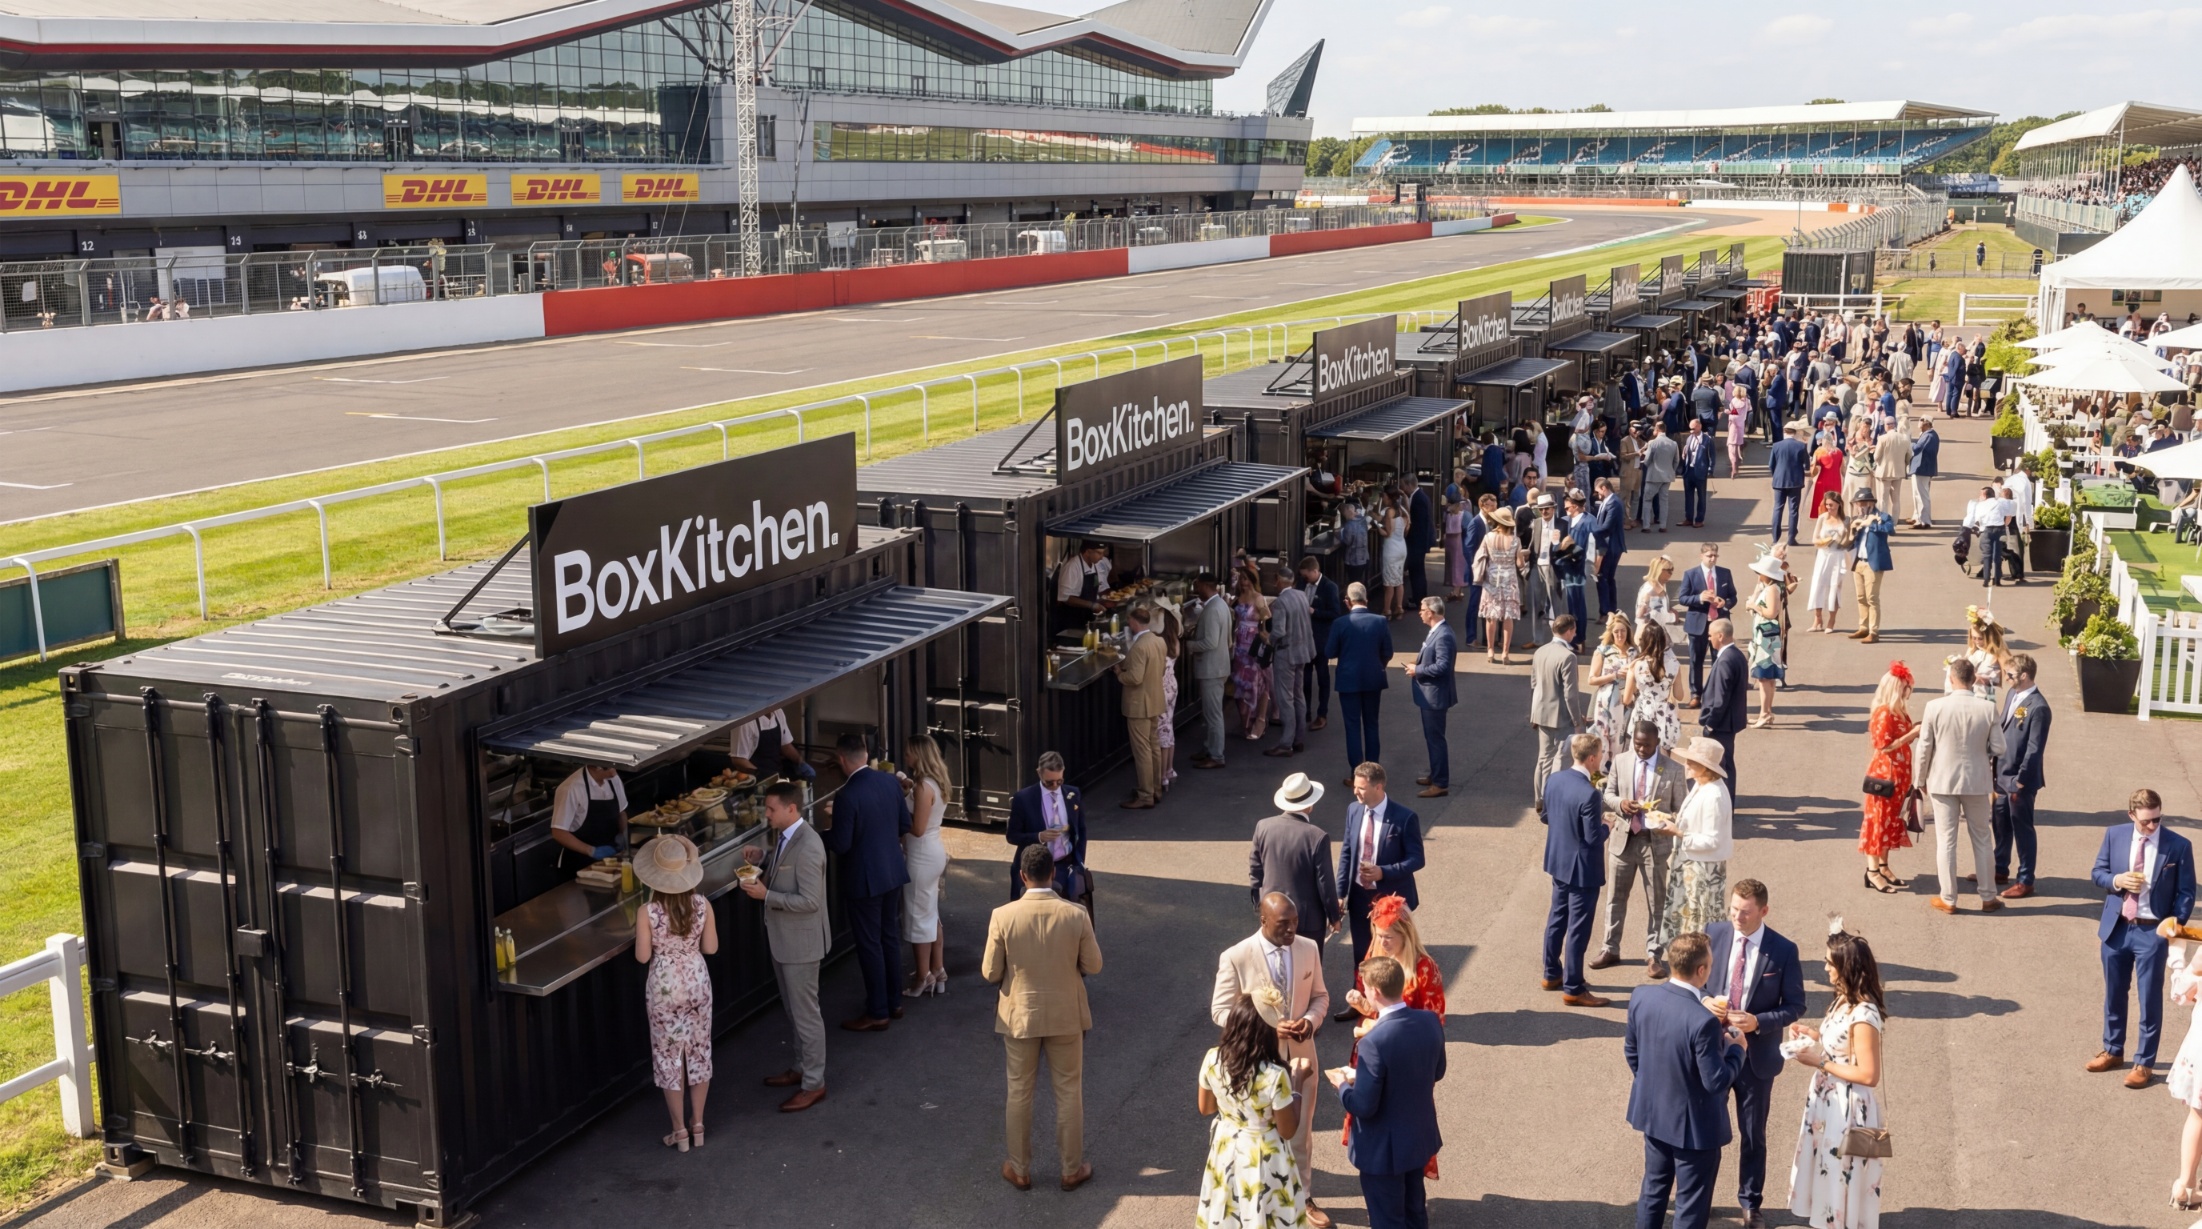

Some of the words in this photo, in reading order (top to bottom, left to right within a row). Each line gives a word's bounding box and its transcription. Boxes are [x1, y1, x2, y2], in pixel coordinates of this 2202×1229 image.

[0, 181, 98, 210] DHL
[401, 180, 473, 202] DHL
[526, 179, 588, 200] DHL
[634, 179, 687, 198] DHL
[81, 240, 95, 251] 12
[1319, 342, 1392, 393] BoxKitchen.
[1067, 396, 1195, 471] BoxKitchen.
[554, 499, 838, 634] BoxKitchen.
